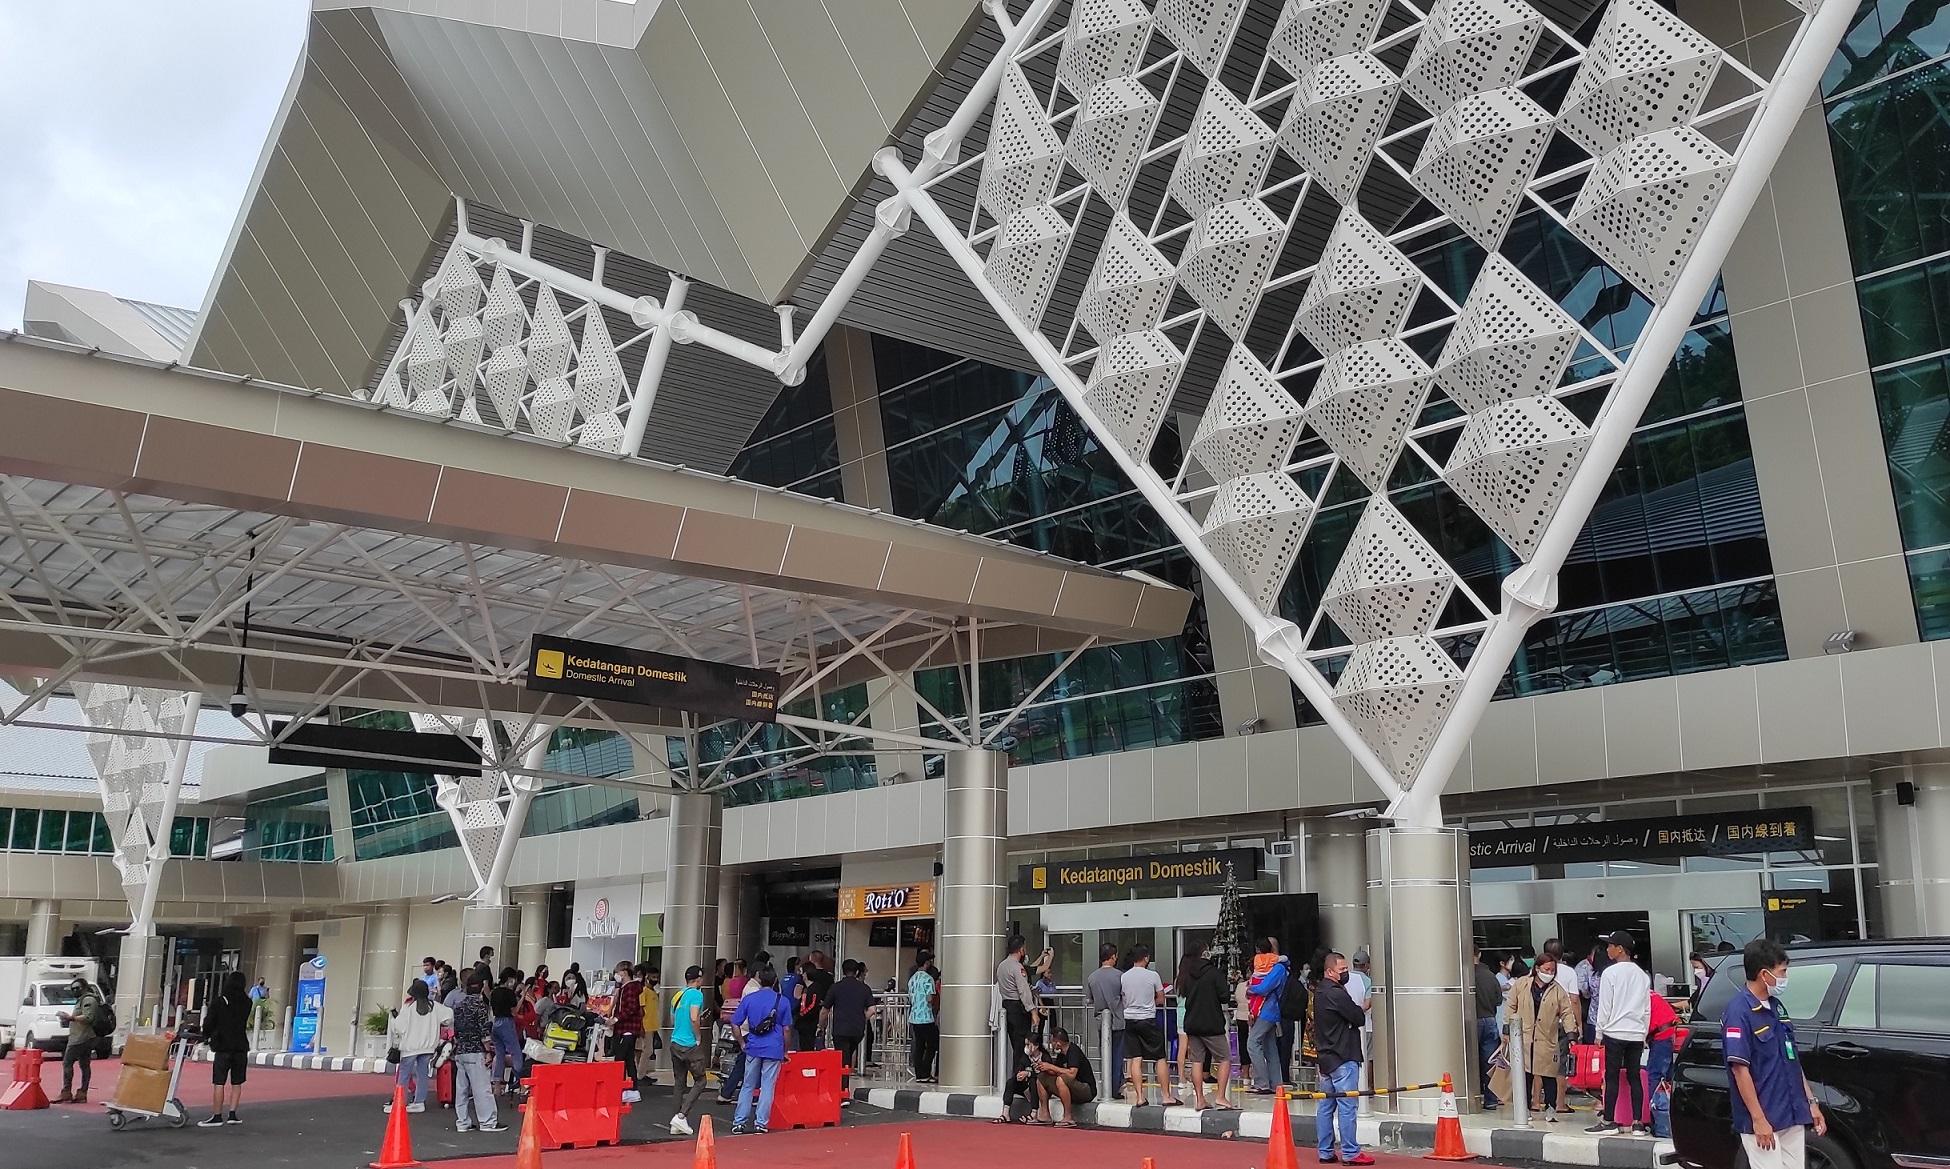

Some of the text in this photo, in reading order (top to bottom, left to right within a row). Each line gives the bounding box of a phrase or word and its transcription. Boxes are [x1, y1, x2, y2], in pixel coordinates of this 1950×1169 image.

[566, 669, 635, 687] Domestic Arrival
[567, 655, 688, 683] Kedatangan Domestik
[1495, 838, 1536, 855] Arrival
[1612, 833, 1638, 846] وصول
[1658, 827, 1706, 845] 国内抵达
[1727, 821, 1797, 840] 国内線到着
[1060, 857, 1222, 885] Kedatangan Domestik
[586, 917, 620, 940] Quickly
